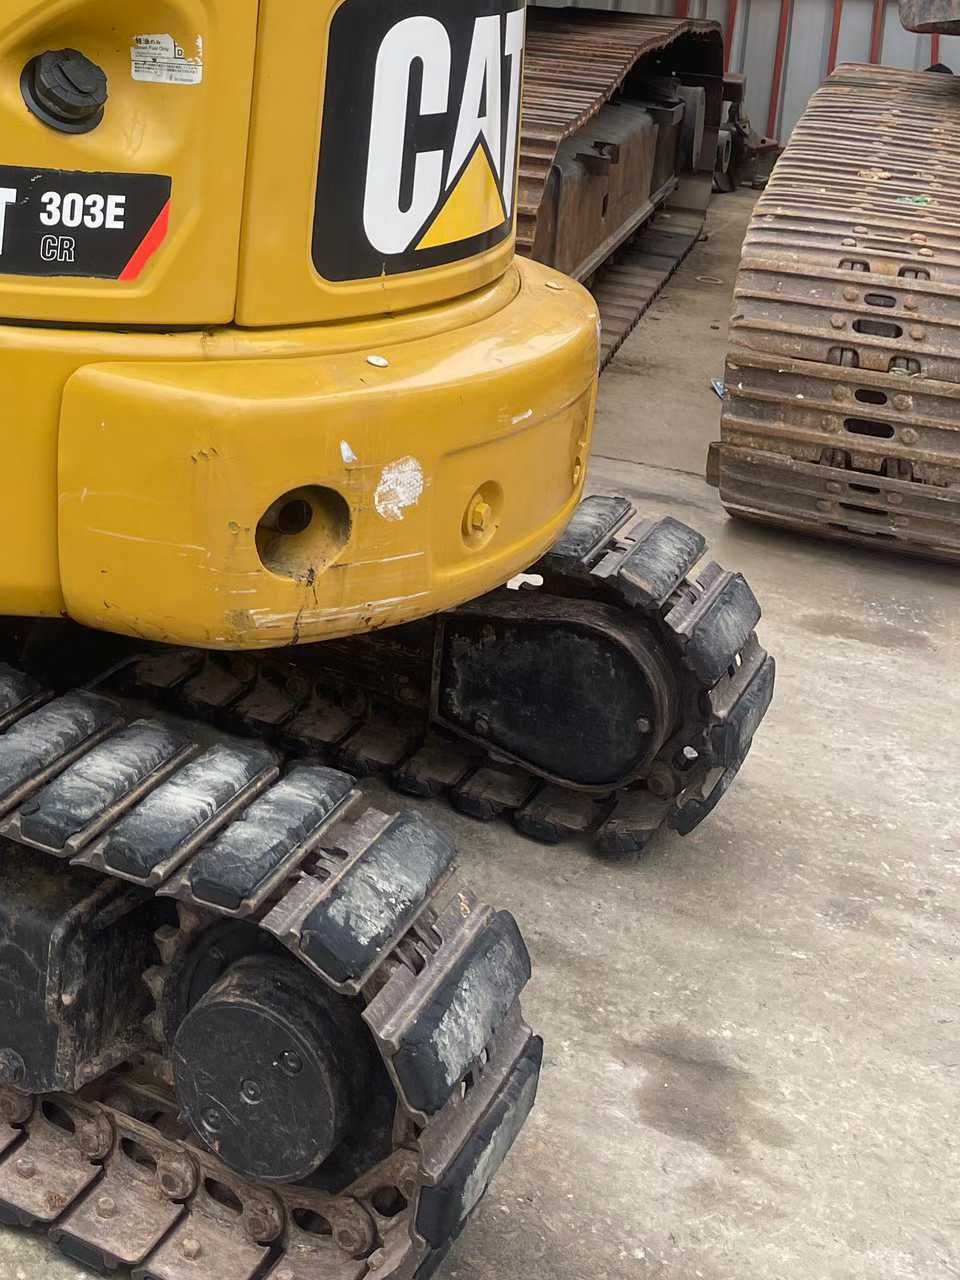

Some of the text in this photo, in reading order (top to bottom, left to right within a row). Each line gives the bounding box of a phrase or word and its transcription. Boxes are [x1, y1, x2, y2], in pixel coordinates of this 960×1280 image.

[363, 7, 525, 255] CAT
[40, 191, 126, 229] 303E
[40, 235, 76, 261] CR
